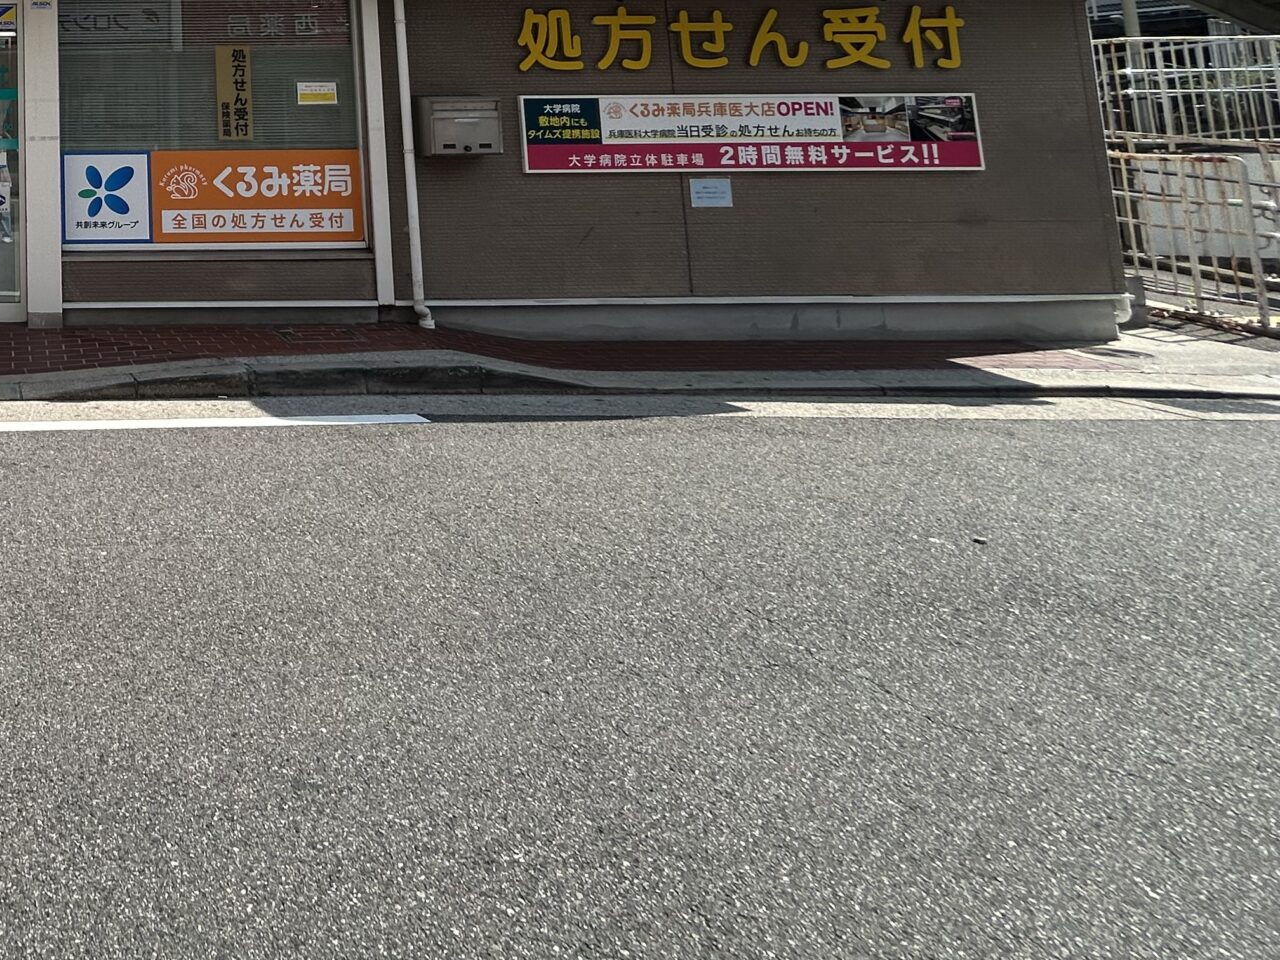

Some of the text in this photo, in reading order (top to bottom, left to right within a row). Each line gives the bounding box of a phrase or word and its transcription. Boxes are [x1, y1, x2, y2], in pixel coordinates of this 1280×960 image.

[517, 6, 966, 72] 処方せん受付
[231, 48, 250, 137] 処方せん受付
[543, 103, 581, 114] 大学病院
[538, 116, 588, 127] 敷地内にも
[527, 129, 601, 140] タイムズ提携施設
[568, 153, 705, 167] 大学病院立体駐車場
[213, 163, 352, 198] くるみ薬局
[75, 220, 139, 229] 共創未来グループ
[171, 212, 345, 229] 全国の処方せん受付
